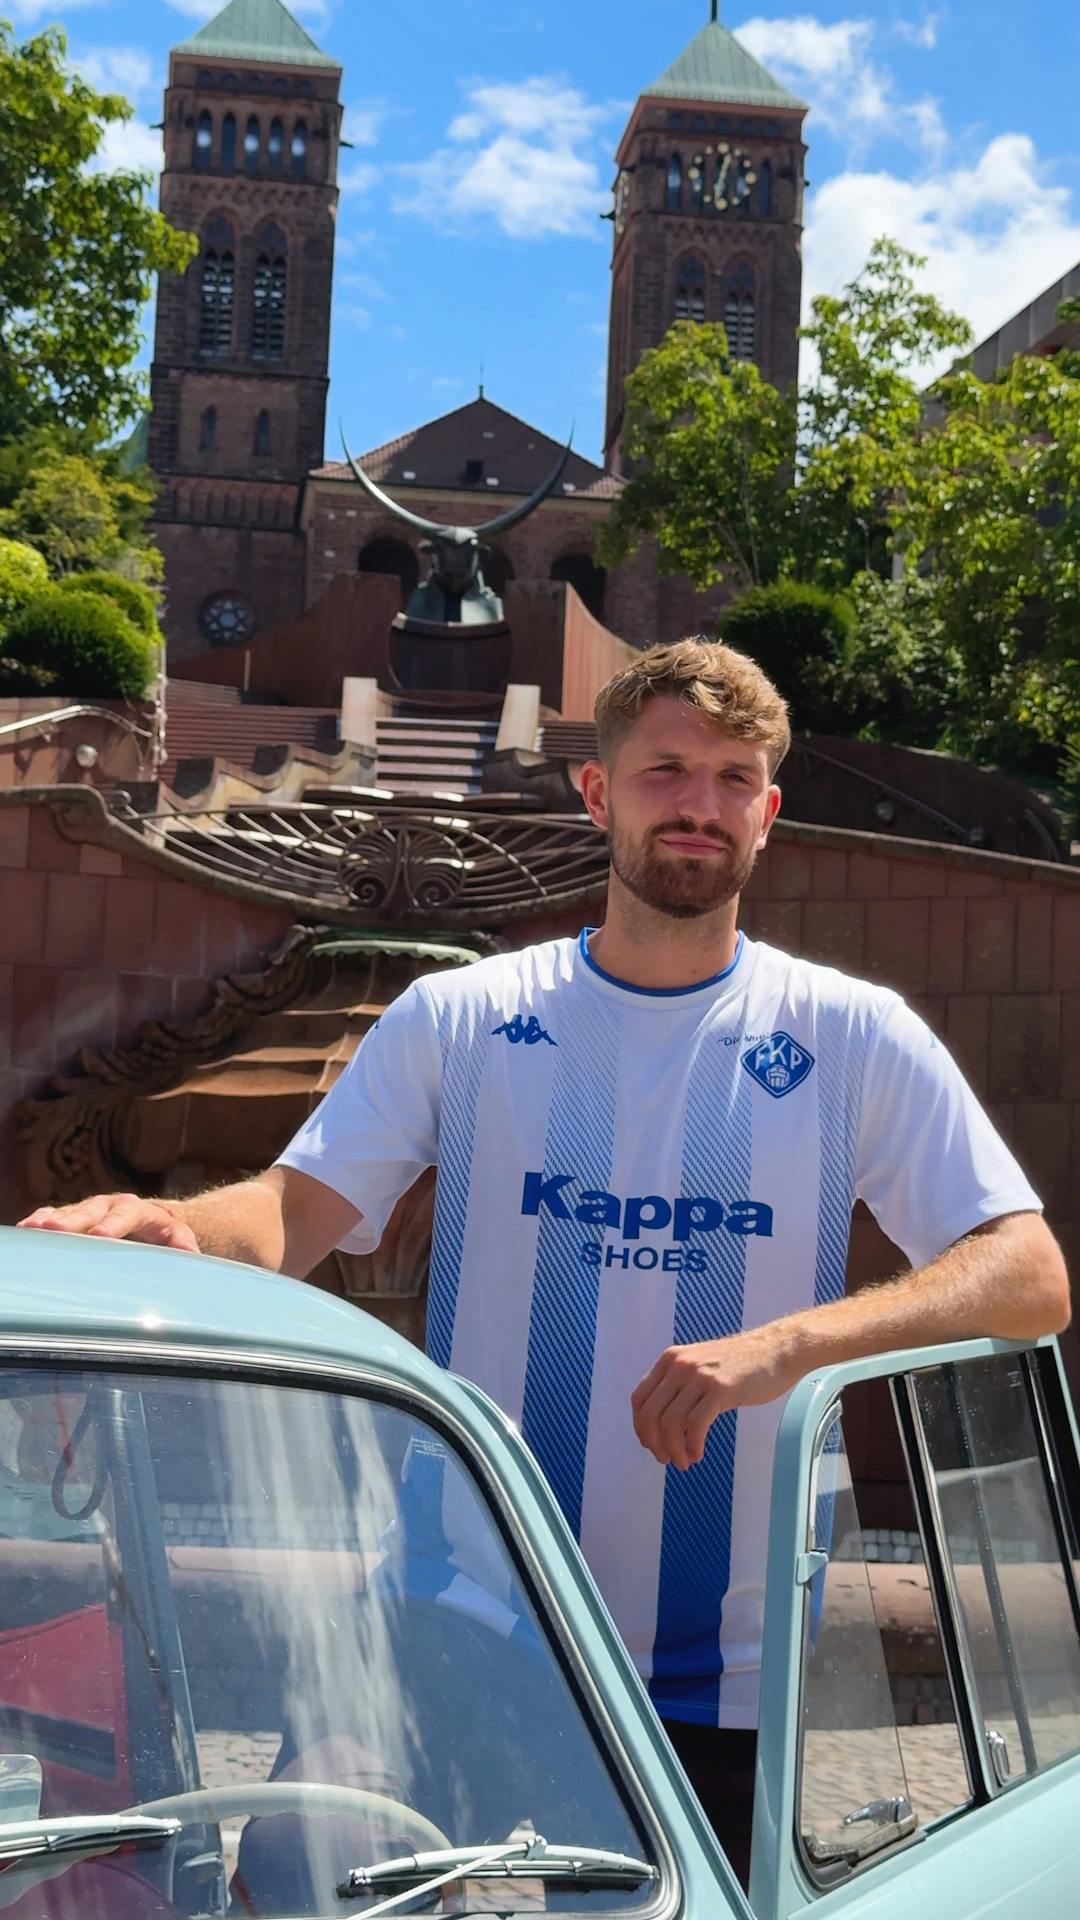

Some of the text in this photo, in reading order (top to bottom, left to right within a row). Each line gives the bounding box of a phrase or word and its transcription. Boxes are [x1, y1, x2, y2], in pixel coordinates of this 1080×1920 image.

[754, 1038, 803, 1072] FKP
[520, 1171, 773, 1241] Kappa
[581, 1242, 709, 1274] SHOES
